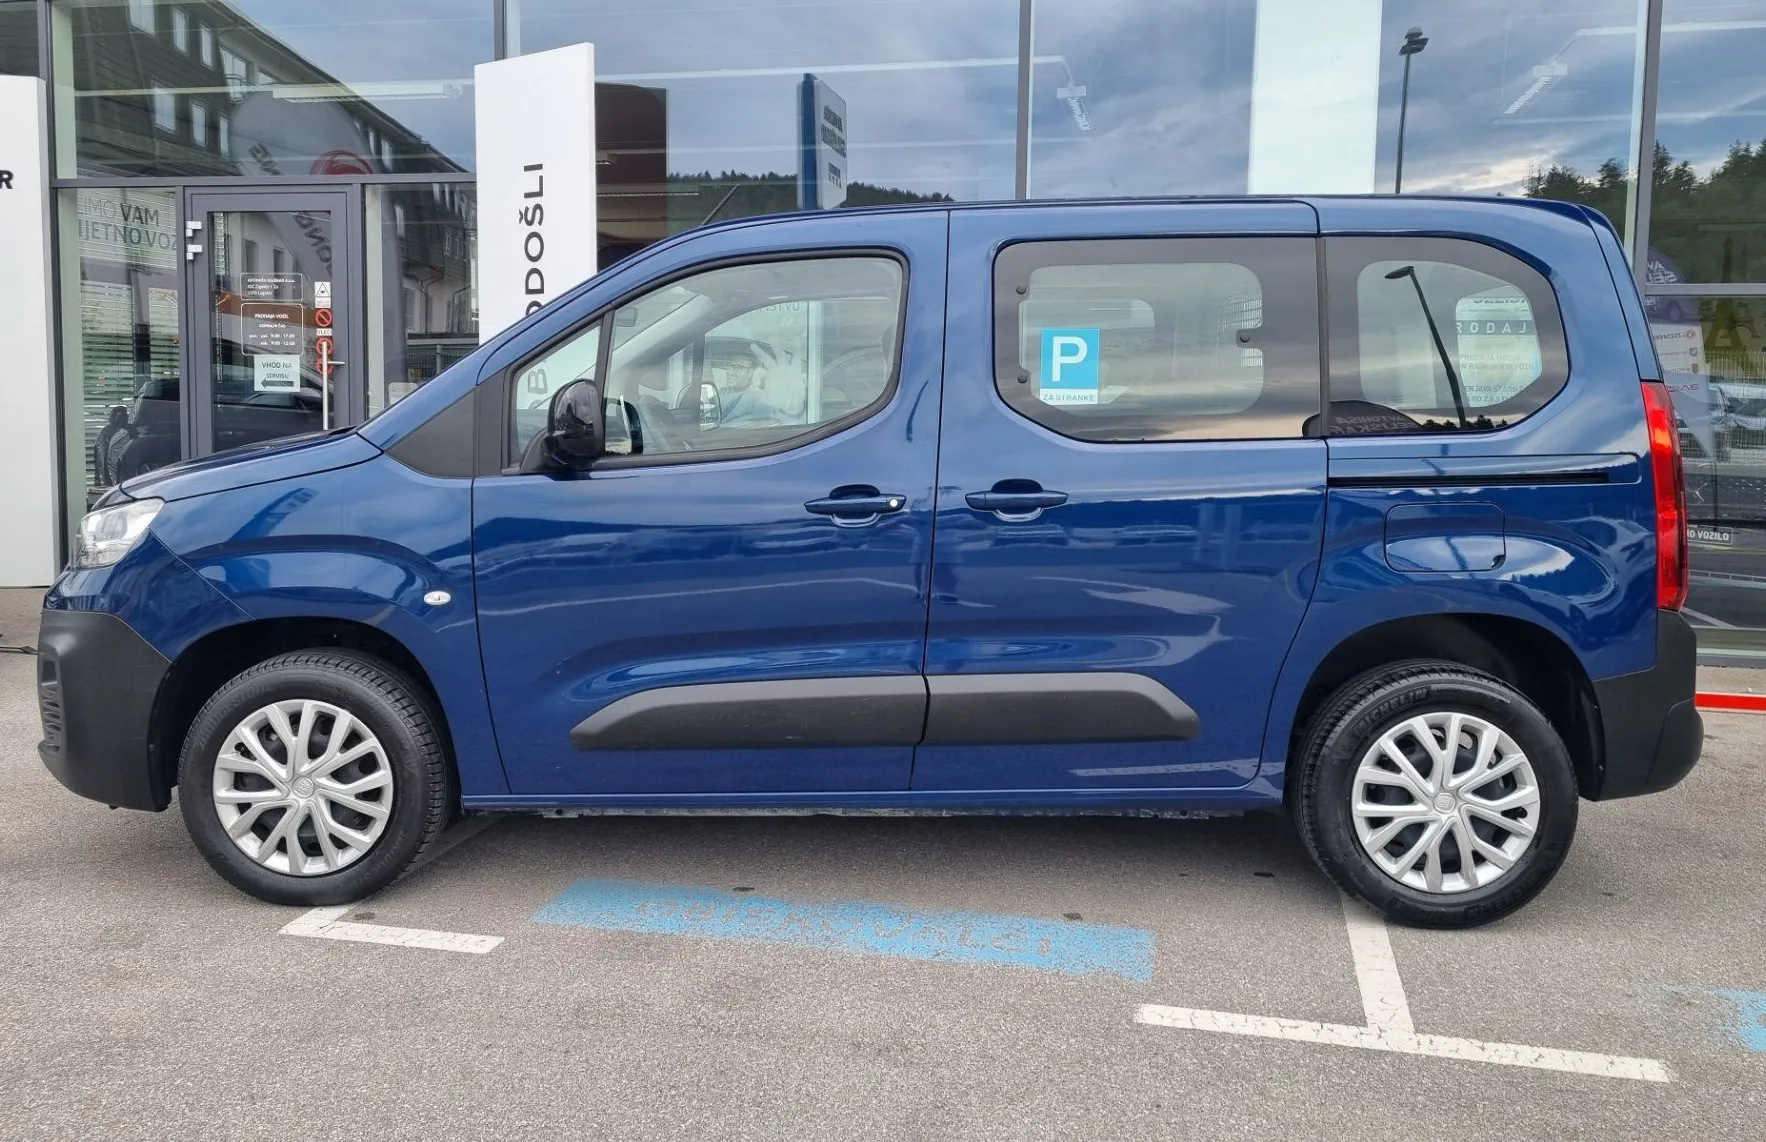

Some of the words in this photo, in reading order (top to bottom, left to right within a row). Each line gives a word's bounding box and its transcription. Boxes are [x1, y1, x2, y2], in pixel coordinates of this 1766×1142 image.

[0, 169, 14, 190] R
[120, 202, 161, 228] VAM
[261, 361, 281, 369] VHOD
[1051, 335, 1088, 382] P
[1697, 530, 1730, 541] VOZILO
